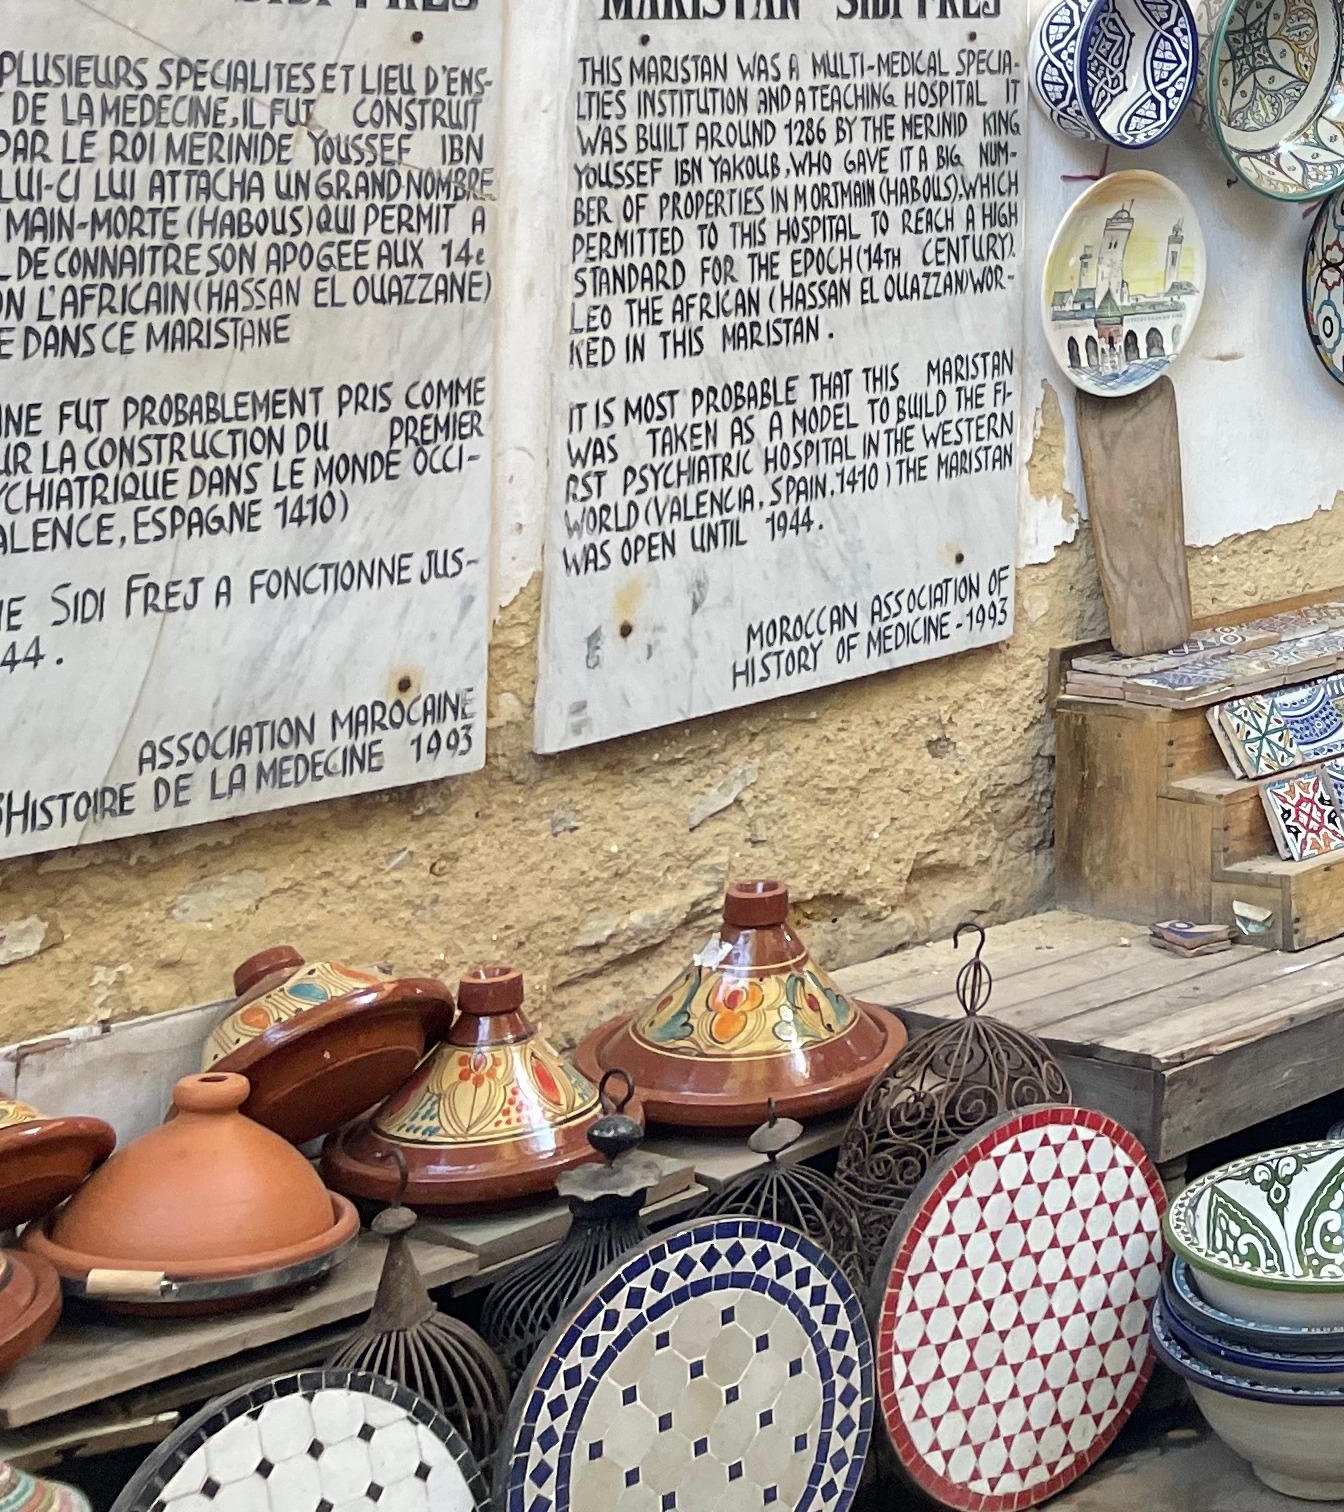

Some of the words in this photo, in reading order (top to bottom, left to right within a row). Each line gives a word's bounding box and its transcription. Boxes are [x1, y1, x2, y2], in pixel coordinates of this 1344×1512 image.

[0, 50, 149, 91] PLUSIEURS
[156, 56, 316, 94] SPECIALITES
[320, 62, 355, 95] ET
[361, 63, 417, 97] LIEU
[577, 52, 623, 89] THIS
[629, 52, 727, 88] MARISTAN
[737, 51, 781, 83] WAS
[789, 53, 799, 81] A
[811, 48, 950, 80] MULTI-MEDICAL
[955, 48, 1020, 77] SPECIA-
[12, 90, 49, 126] DE
[61, 92, 94, 128] LA
[242, 96, 266, 130] IL
[268, 97, 313, 126] FUT
[353, 96, 483, 133] CONSTRUIT
[576, 122, 627, 159] WAS
[635, 121, 689, 155] BUILT
[696, 118, 776, 153] AROUND
[784, 116, 826, 147] 1286
[834, 115, 857, 147] BY
[860, 113, 896, 144] THE
[901, 111, 968, 142] MERINID
[983, 109, 1021, 137] KING
[61, 129, 98, 165] LE
[109, 130, 155, 166] ROI
[165, 130, 294, 166] MERINIDE
[307, 133, 413, 168] YOUSSEF
[441, 134, 484, 166] IBN
[573, 158, 664, 189] YOUSSEF
[674, 156, 702, 188] IBN
[789, 149, 832, 178] WHO
[844, 145, 890, 175] GAVE
[900, 145, 914, 173] IT
[919, 145, 928, 172] A
[935, 144, 965, 172] BIG
[979, 140, 1017, 168] NUM-
[6, 204, 181, 244] MAIN-MORTE
[186, 205, 313, 240] (HABOUS)
[316, 203, 355, 235] QUI
[363, 202, 457, 236] PERMIT
[472, 205, 485, 235] A
[573, 196, 614, 228] BER
[622, 193, 649, 225] OF
[659, 186, 766, 216] PROPERTIES
[771, 185, 789, 214] IN
[794, 178, 876, 213] MORTMAIN
[958, 170, 1018, 201] WHICH
[17, 246, 50, 282] DE
[54, 241, 202, 282] CONNAITRE
[205, 241, 257, 278] SON
[266, 239, 372, 276] APOGEE
[377, 237, 424, 271] AUX
[572, 226, 684, 261] PERMITTED
[697, 221, 718, 251] TO
[729, 216, 766, 250] THIS
[777, 213, 862, 244] HOSPITAL
[871, 210, 889, 238] TO
[901, 205, 954, 235] REACH
[966, 204, 975, 233] A
[982, 201, 1018, 231] HIGH
[573, 264, 686, 298] STANDARD
[700, 254, 739, 288] FOR
[747, 250, 780, 284] THE
[790, 244, 852, 279] EPOCH
[58, 398, 110, 436] FUT
[123, 386, 325, 432] PROBABLEMENT
[337, 381, 393, 419] PRIS
[405, 376, 486, 410] COMME
[569, 402, 588, 435] IT
[595, 396, 616, 430] IS
[624, 389, 680, 427] MOST
[691, 375, 800, 418] PROBABLE
[809, 368, 853, 403] THAT
[862, 362, 899, 394] THIS
[927, 347, 1014, 386] MARISTAN
[562, 539, 611, 577] WAS
[621, 528, 676, 566] OPEN
[690, 516, 748, 553] UNTIL
[51, 582, 105, 627] SIDI
[125, 575, 205, 619] FREJ
[215, 575, 231, 610] A
[250, 552, 414, 604] FONCTIONNE
[420, 547, 479, 585] JUS-
[746, 601, 860, 651] MOROCCAN
[870, 572, 982, 623] ASSOCIATION
[988, 565, 1010, 597] OF
[732, 643, 825, 691] HISTORY
[836, 632, 860, 664] OF
[867, 614, 951, 658] MEDICINE
[138, 712, 316, 774] ASSOCIATION
[331, 688, 475, 742] MAROCAINE
[154, 772, 195, 812] DE
[210, 763, 246, 800] LA
[256, 739, 385, 794] MEDECINE
